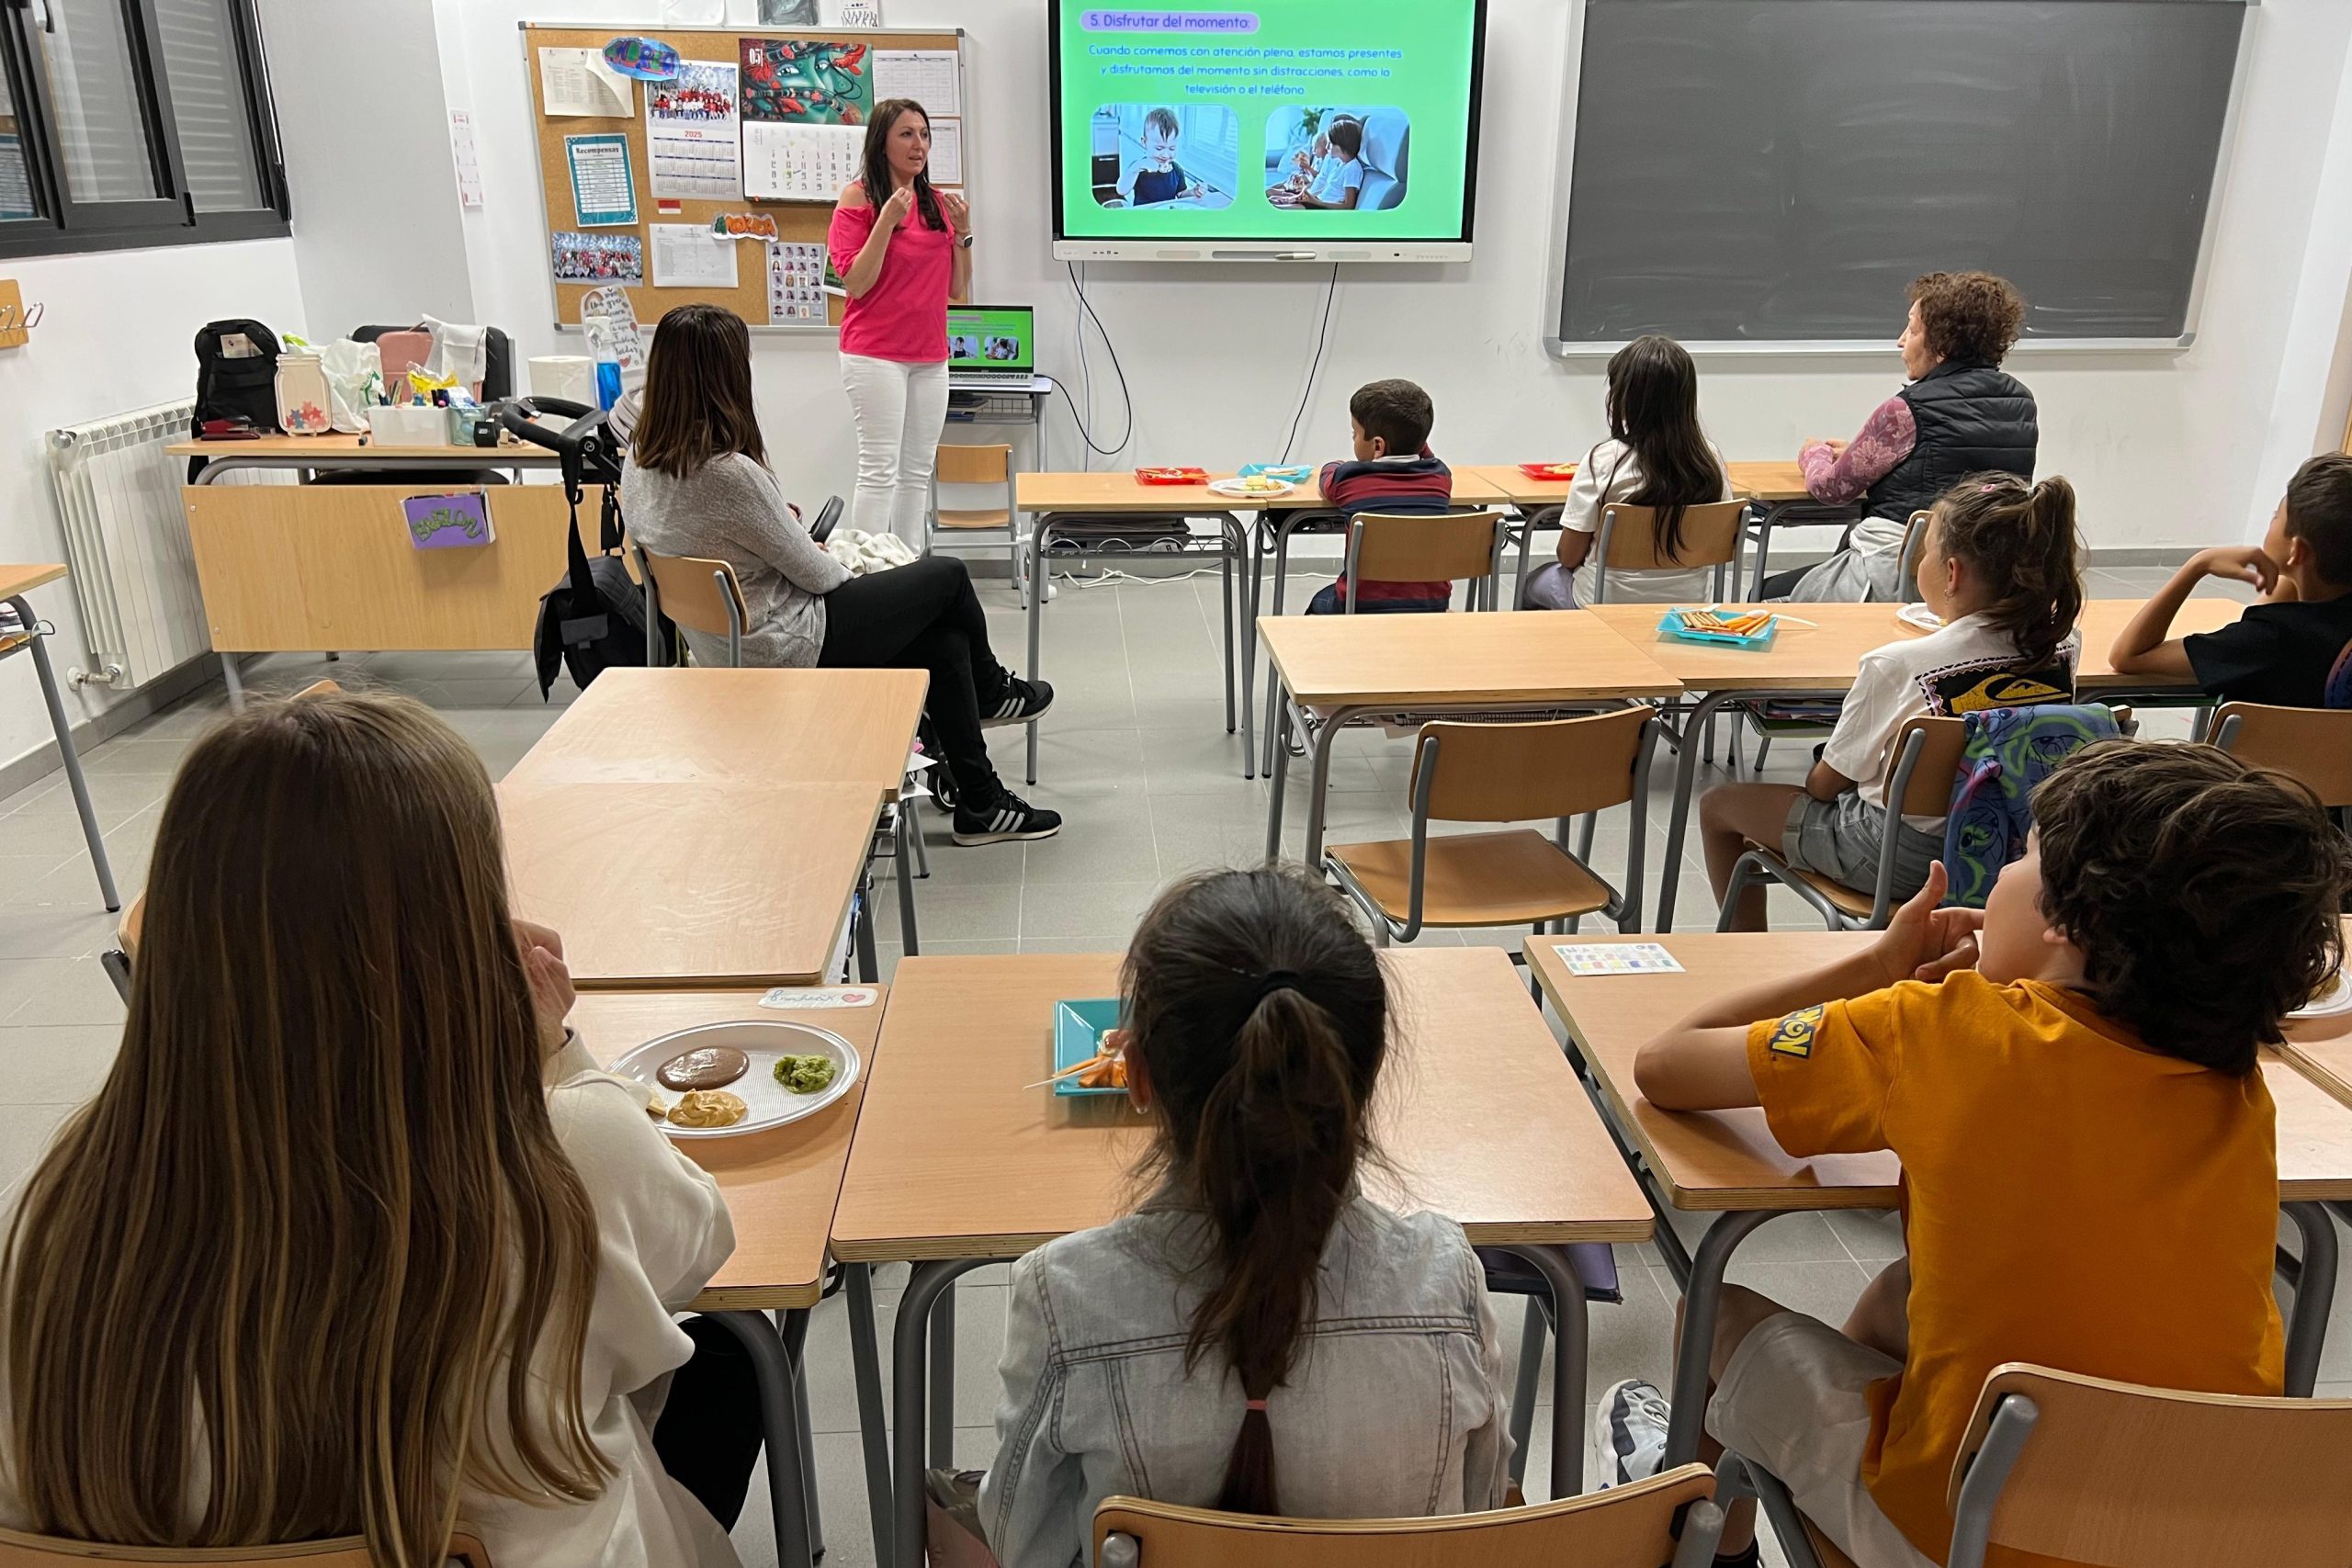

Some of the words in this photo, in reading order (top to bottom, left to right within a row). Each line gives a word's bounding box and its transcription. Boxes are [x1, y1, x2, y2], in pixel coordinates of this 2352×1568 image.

[1090, 14, 1101, 27] 5.
[1103, 14, 1159, 28] Disfrutar
[1162, 15, 1182, 28] del
[1184, 17, 1250, 28] momento:
[1088, 44, 1131, 56] Cuando
[1134, 47, 1188, 57] comemos
[1190, 47, 1210, 57] con
[1212, 46, 1261, 58] atención
[1298, 48, 1345, 59] estamos
[1348, 49, 1402, 61] presentes
[1101, 66, 1106, 75] y
[1109, 64, 1175, 75] disfrutamos
[1177, 65, 1193, 75] del
[1196, 65, 1250, 76] momento
[1253, 66, 1268, 76] sin
[1347, 68, 1378, 77] como
[1380, 67, 1390, 77] la
[1184, 84, 1236, 95] televisión
[1238, 85, 1246, 95] o
[1248, 85, 1258, 95] el
[1261, 84, 1305, 96] teléfono
[684, 130, 703, 139] 2025
[575, 147, 619, 155] Recompensas
